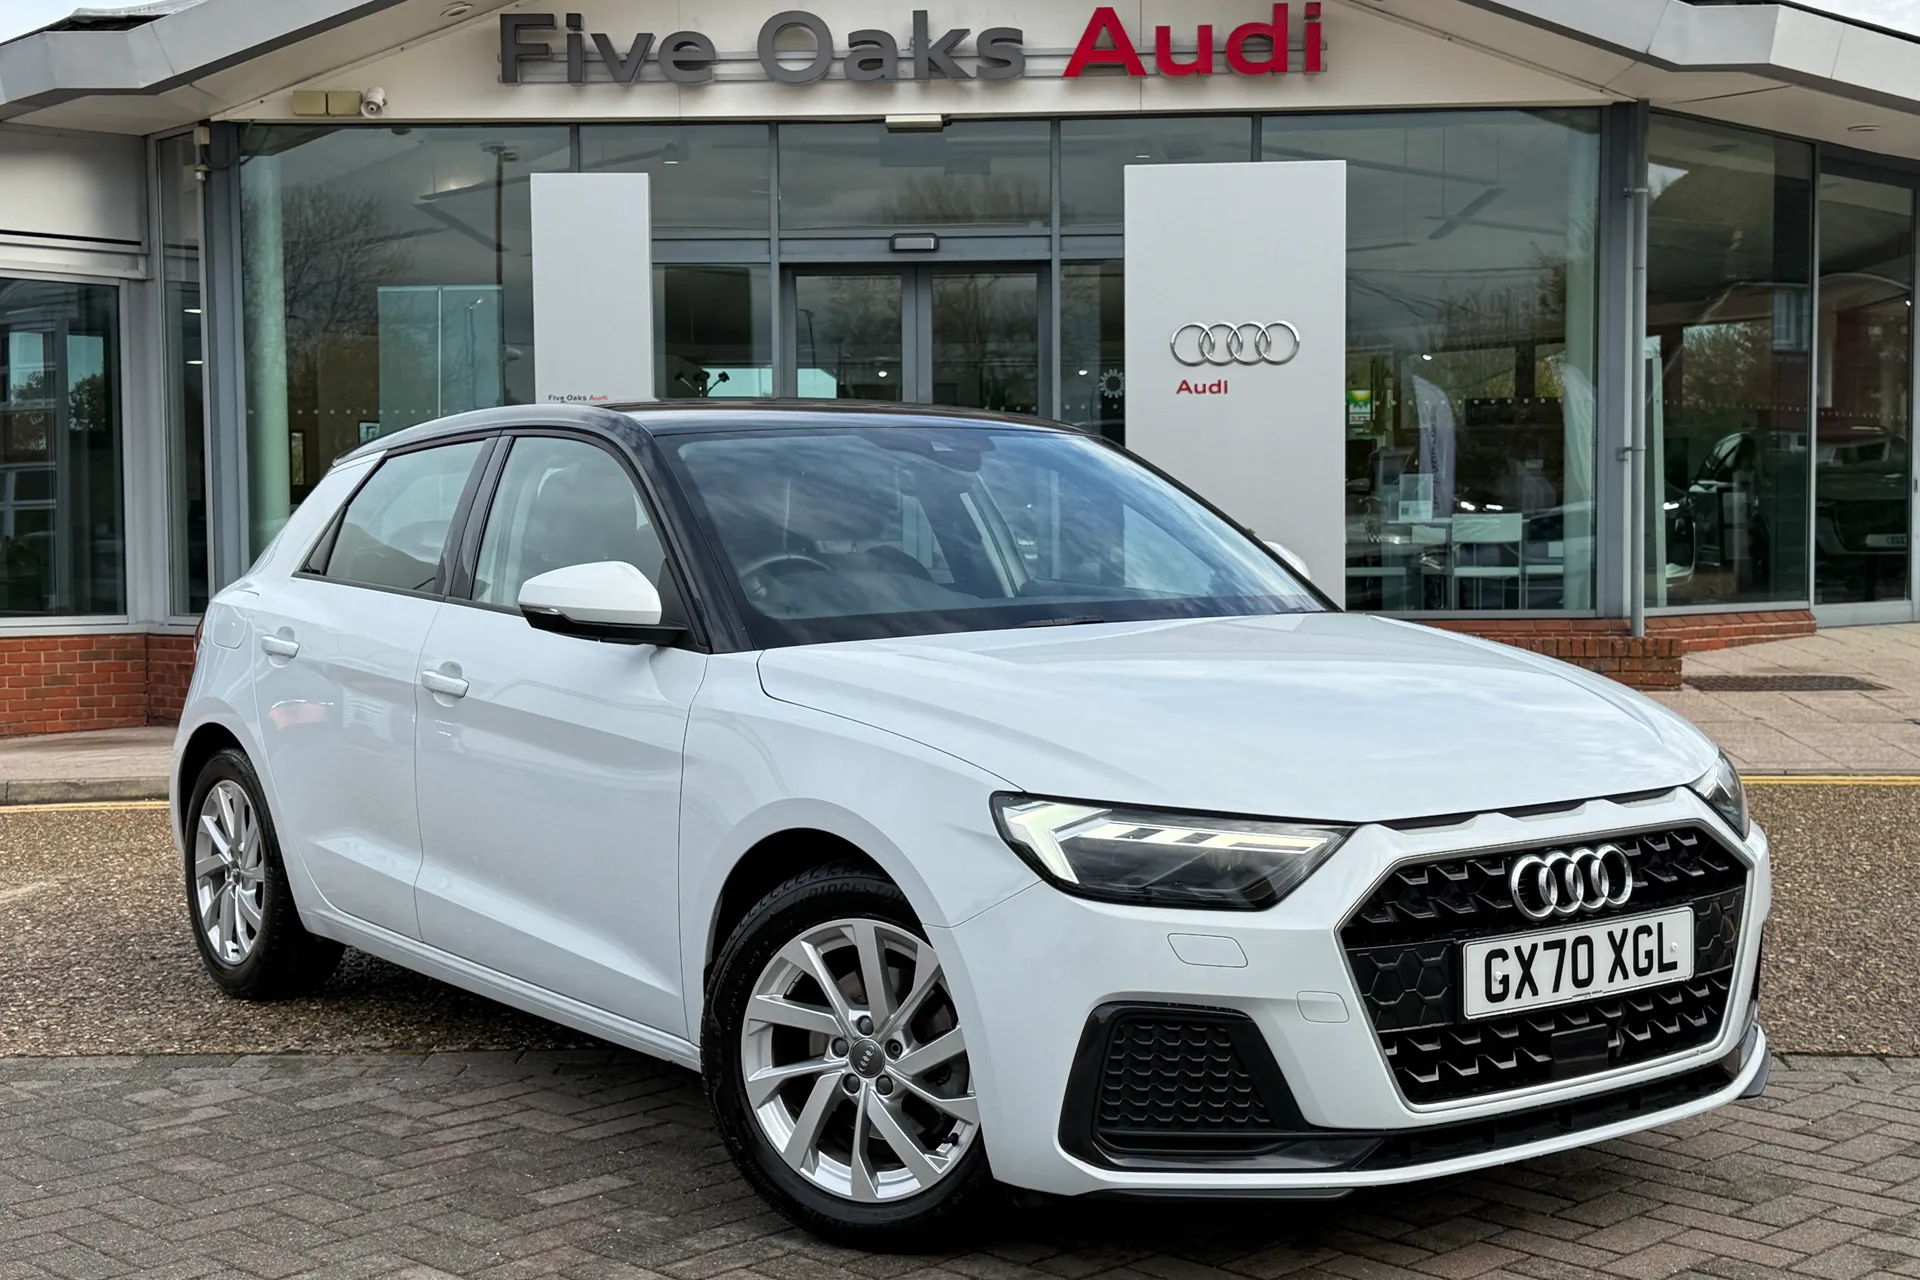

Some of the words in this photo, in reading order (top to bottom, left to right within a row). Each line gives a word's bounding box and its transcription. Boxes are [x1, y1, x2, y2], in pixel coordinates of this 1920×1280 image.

[500, 12, 716, 85] Five
[757, 9, 1026, 84] Oaks
[1062, 2, 1322, 77] Audi
[566, 394, 587, 402] Oaks
[1175, 379, 1229, 395] Audi
[1484, 934, 1595, 1004] GX70
[1606, 921, 1678, 984] XGL
